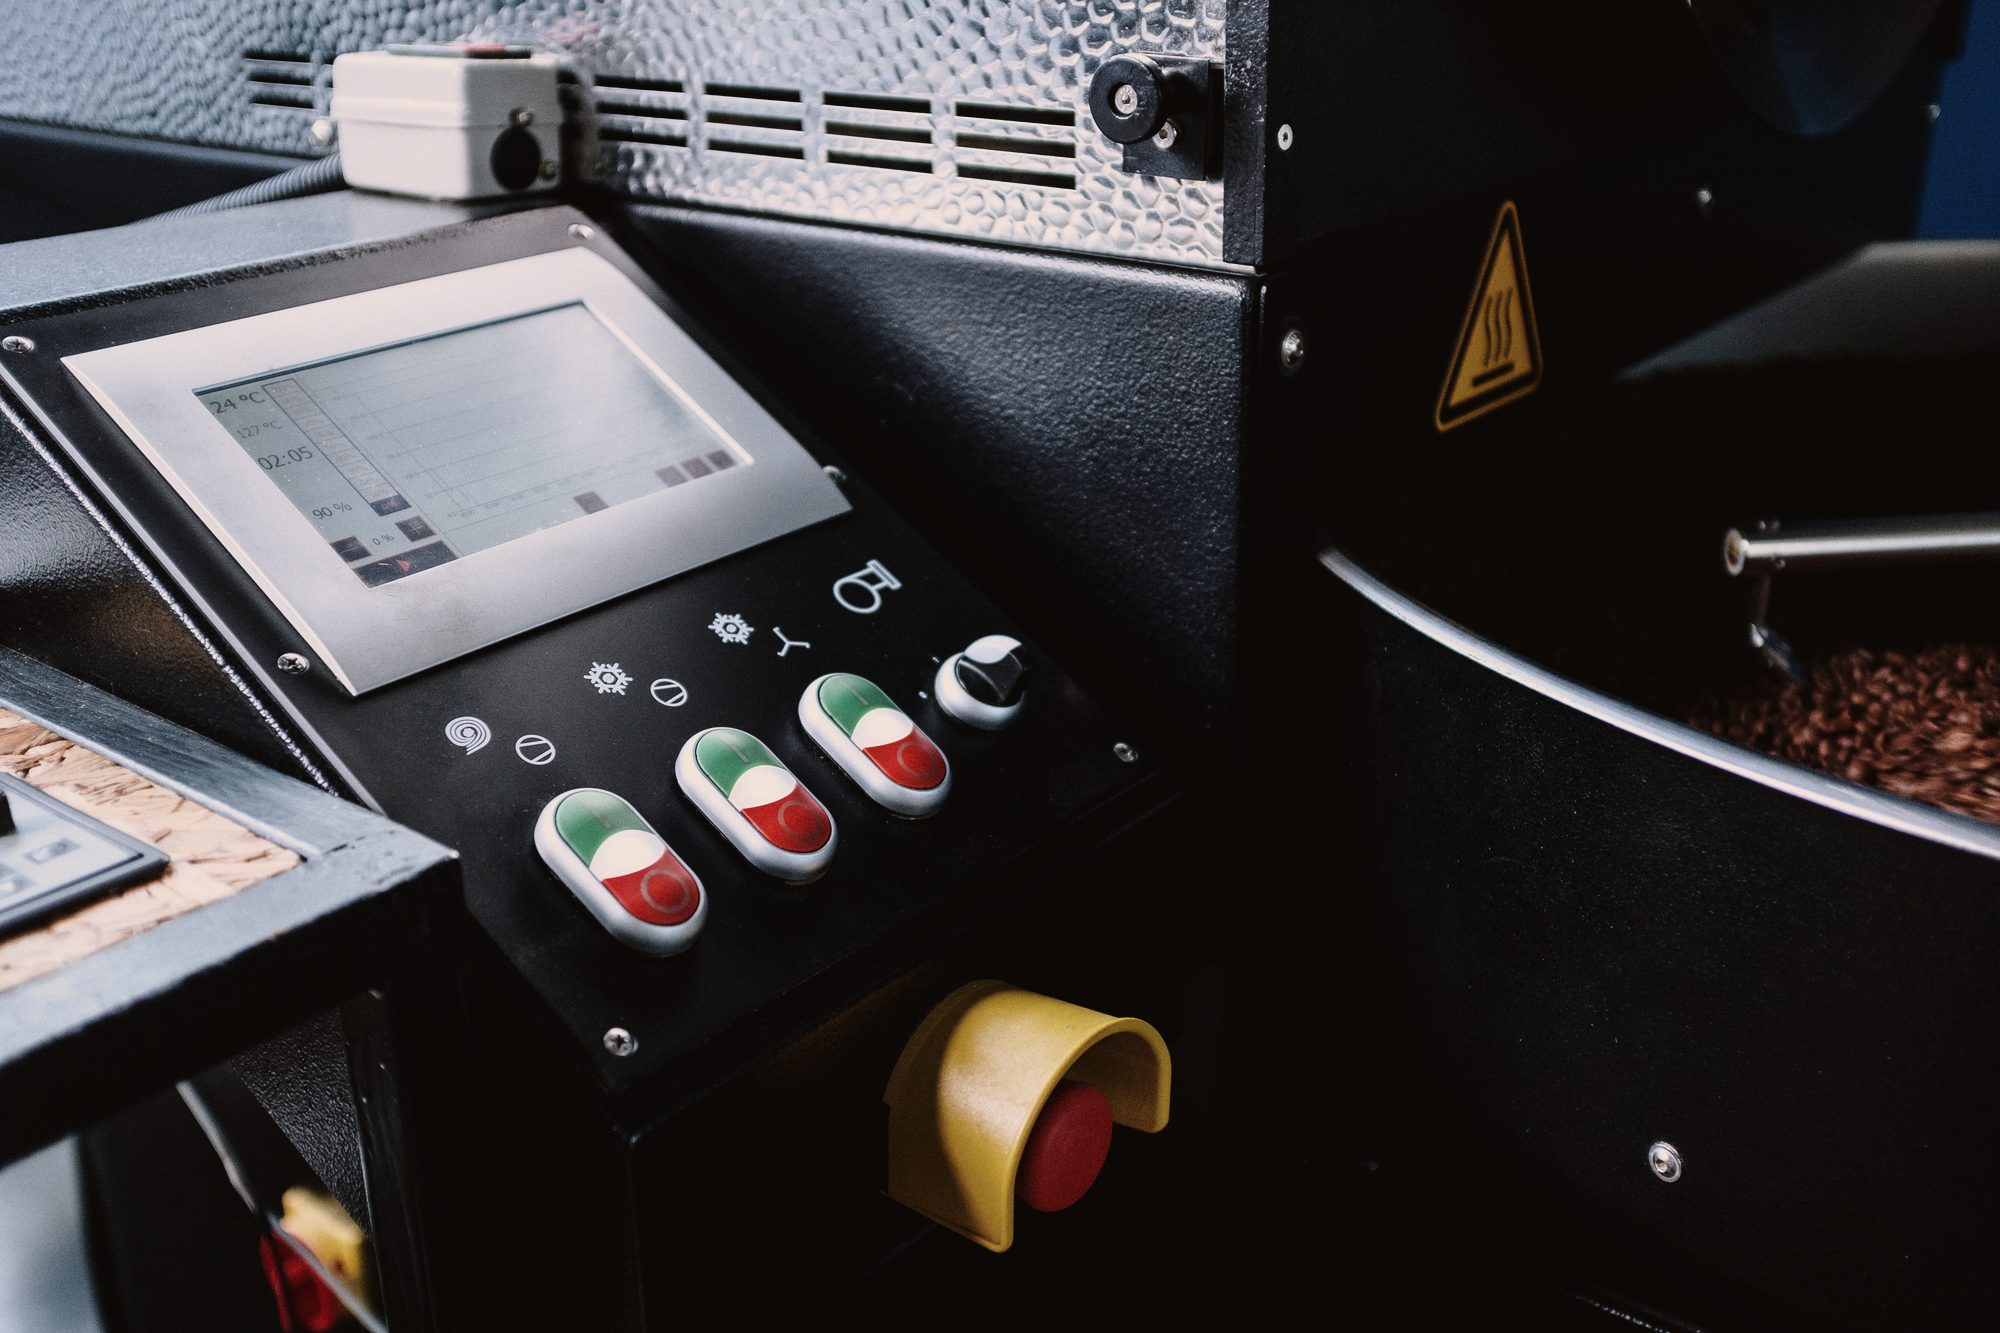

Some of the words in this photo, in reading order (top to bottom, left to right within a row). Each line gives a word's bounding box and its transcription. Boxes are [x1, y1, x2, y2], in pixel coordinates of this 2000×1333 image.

[209, 398, 238, 414] 24
[236, 425, 260, 440] 127
[257, 446, 313, 470] 02:05
[312, 506, 334, 520] 90
